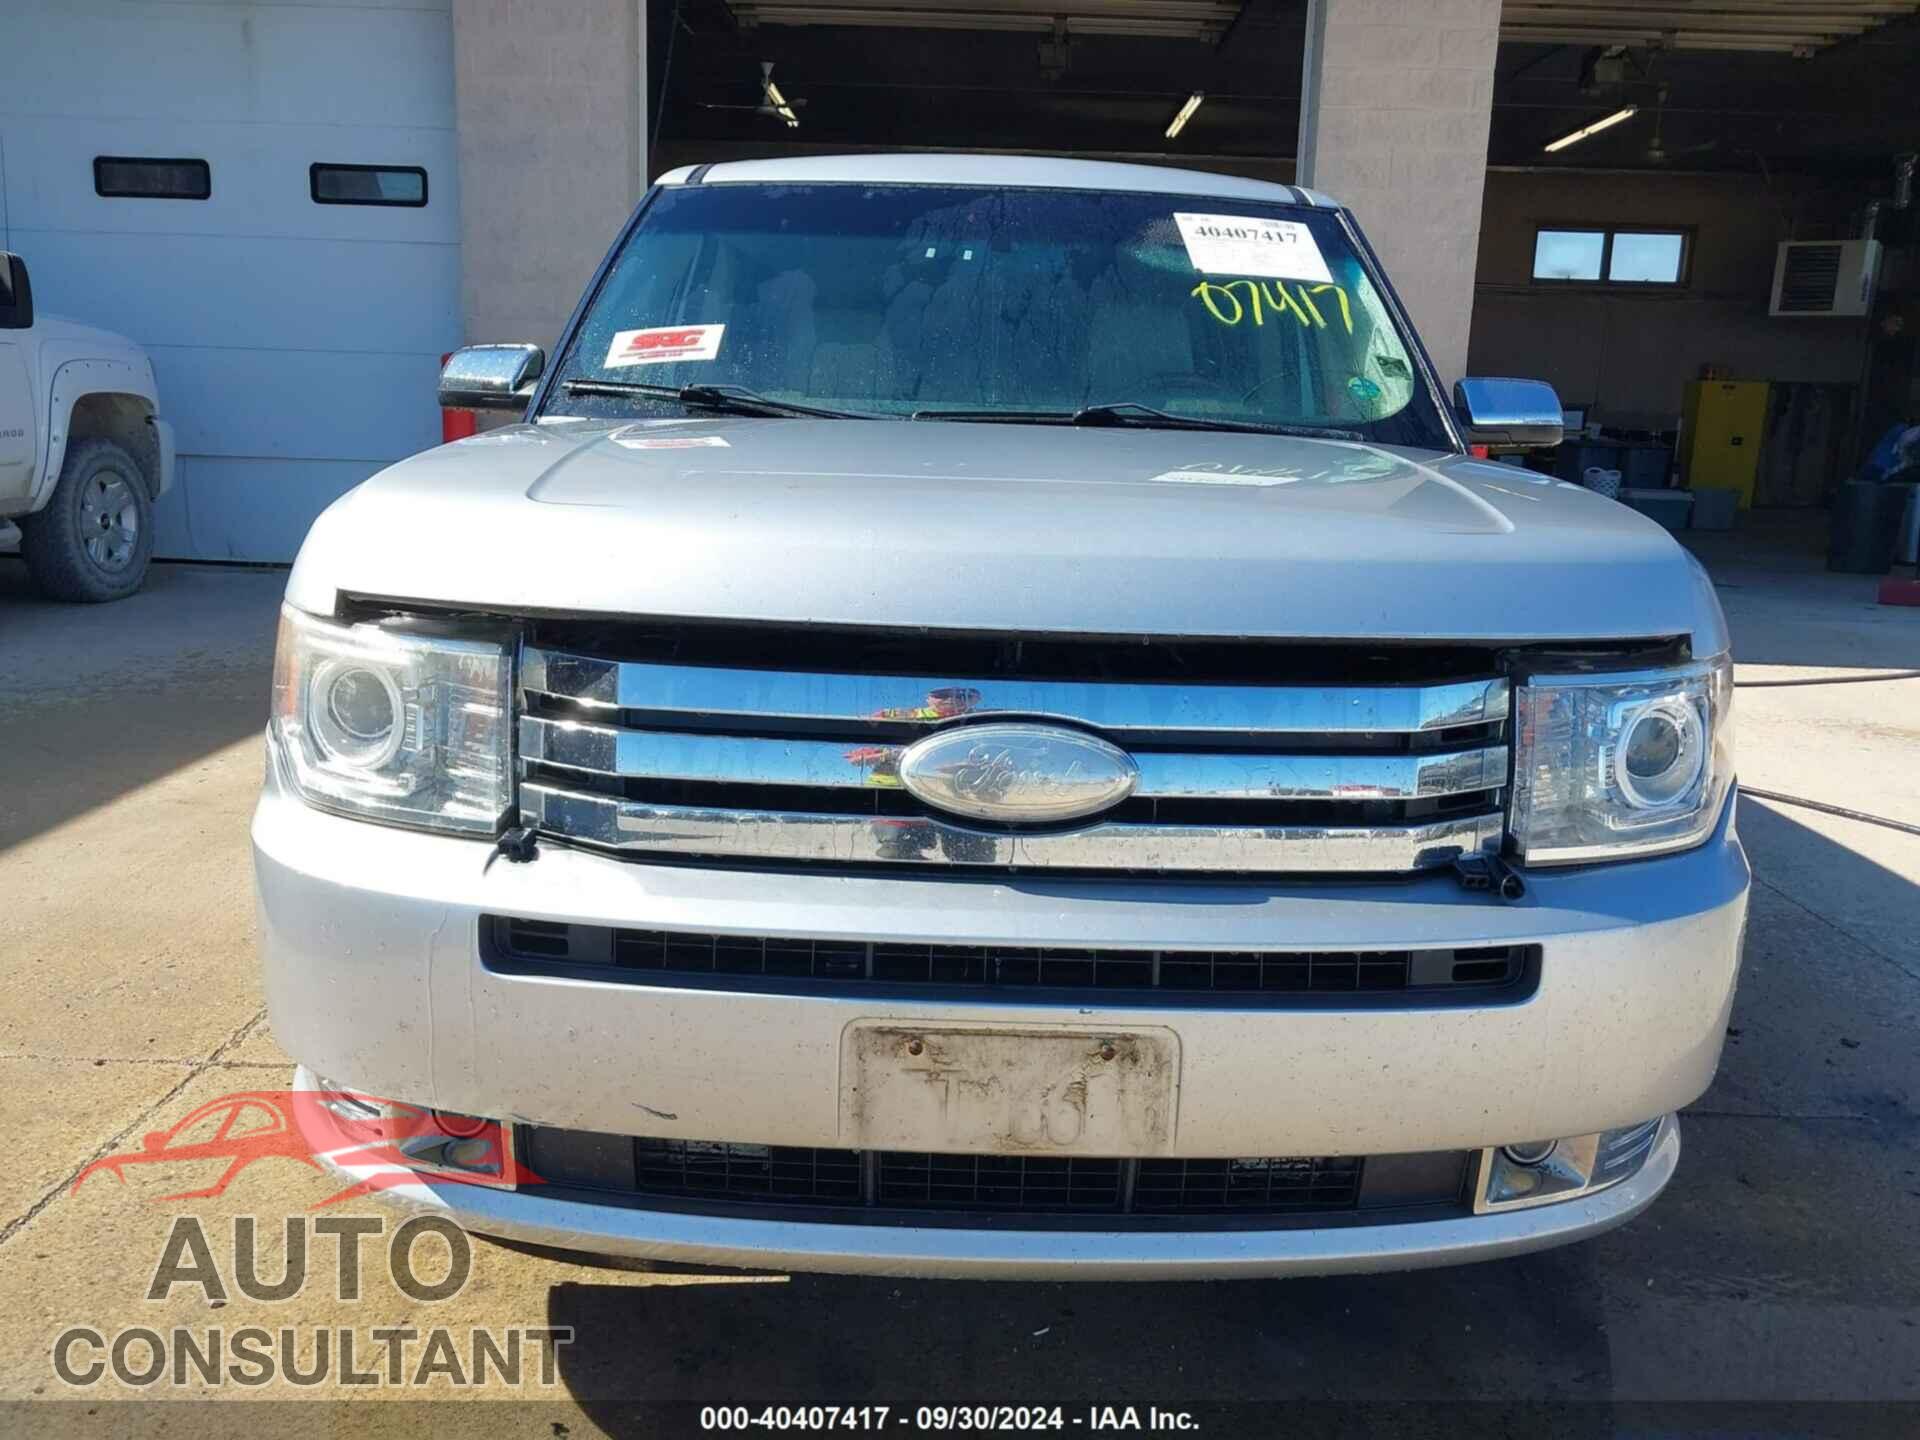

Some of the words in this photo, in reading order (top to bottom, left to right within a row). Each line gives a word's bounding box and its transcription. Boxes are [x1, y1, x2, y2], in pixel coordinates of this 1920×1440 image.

[1195, 225, 1298, 244] 40407417
[1191, 281, 1353, 335] 07417
[953, 743, 1082, 797] Ford
